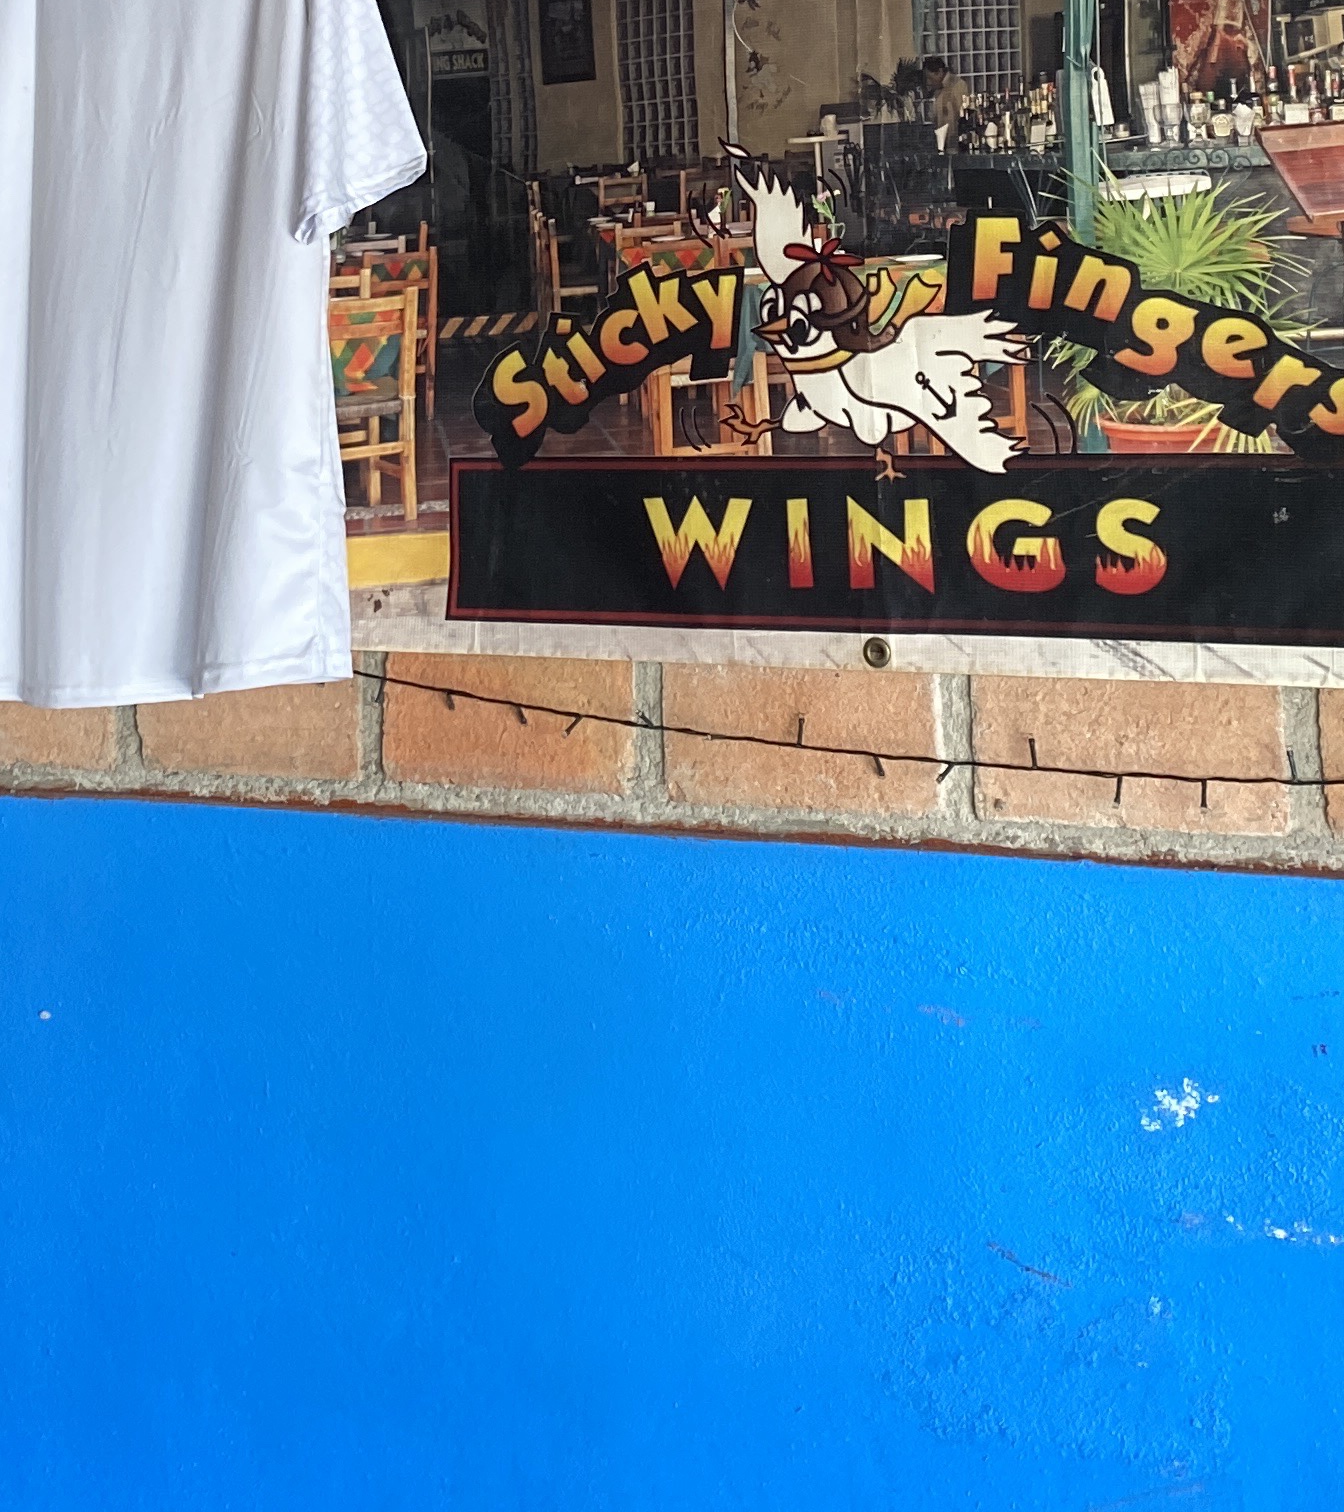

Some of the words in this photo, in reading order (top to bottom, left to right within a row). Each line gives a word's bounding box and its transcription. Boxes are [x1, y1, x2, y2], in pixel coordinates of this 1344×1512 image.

[453, 52, 484, 70] SHACK
[506, 266, 742, 440] Sticky
[645, 496, 1170, 596] WINGS
